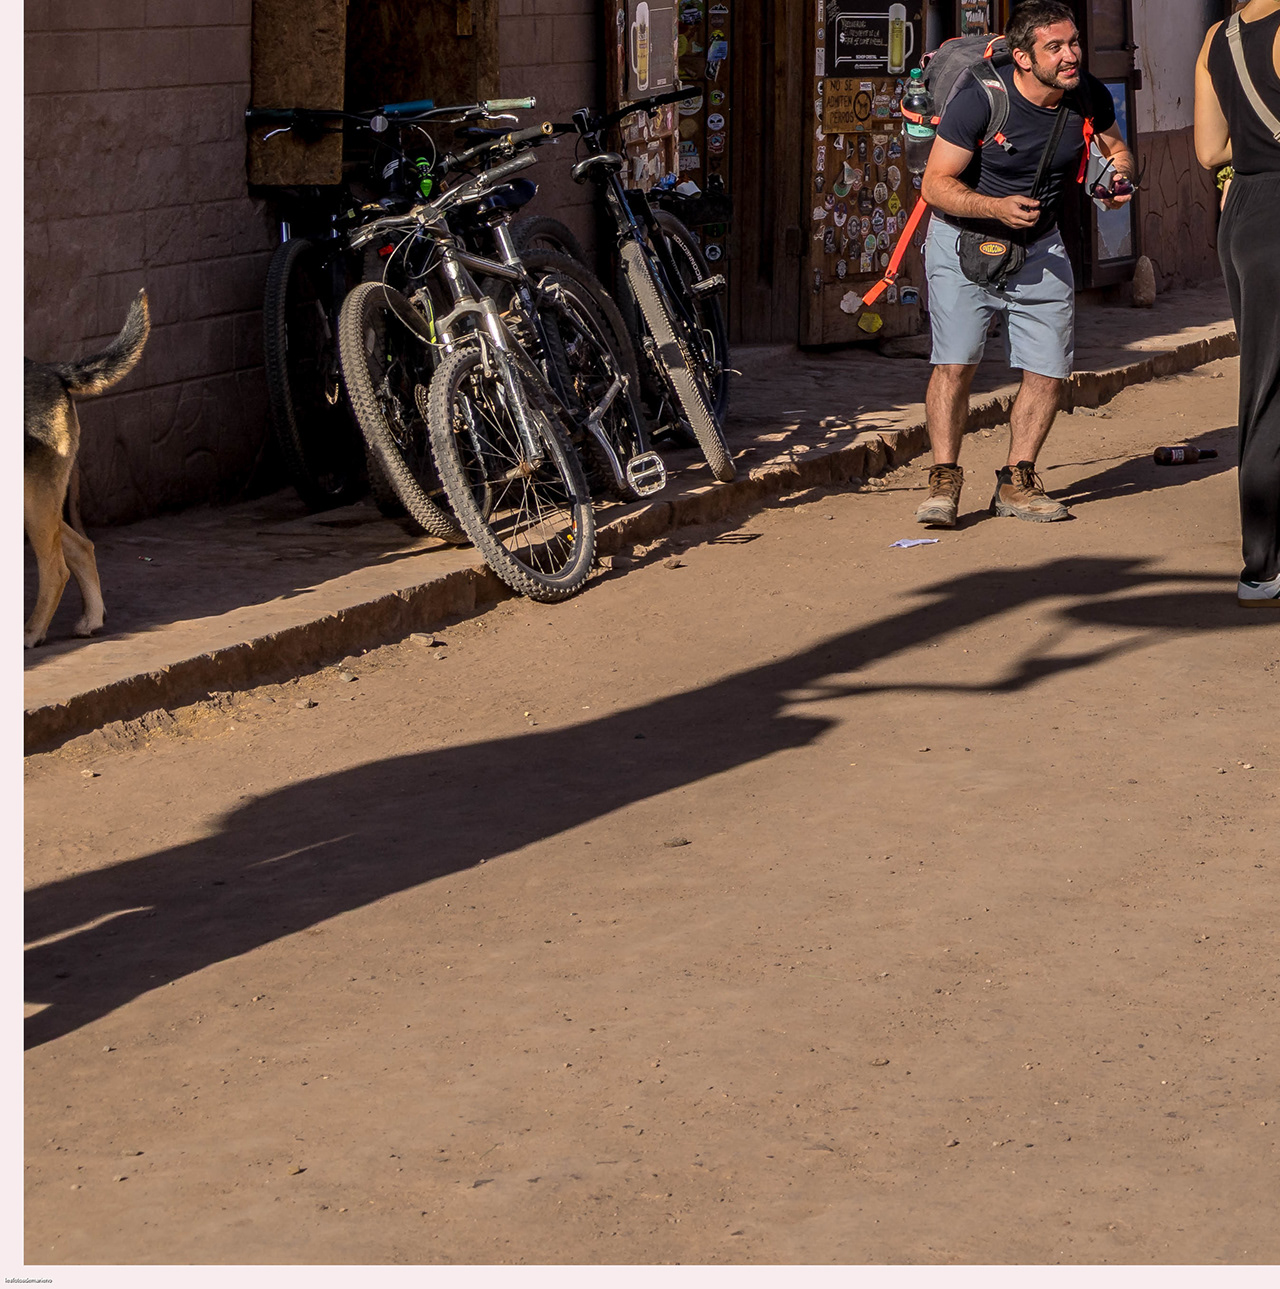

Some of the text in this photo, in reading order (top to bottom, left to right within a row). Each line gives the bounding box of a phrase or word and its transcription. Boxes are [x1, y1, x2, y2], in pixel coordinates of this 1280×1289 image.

[830, 79, 854, 91] NO SE
[827, 96, 853, 108] ADMITEN
[830, 111, 855, 124] PERROS
